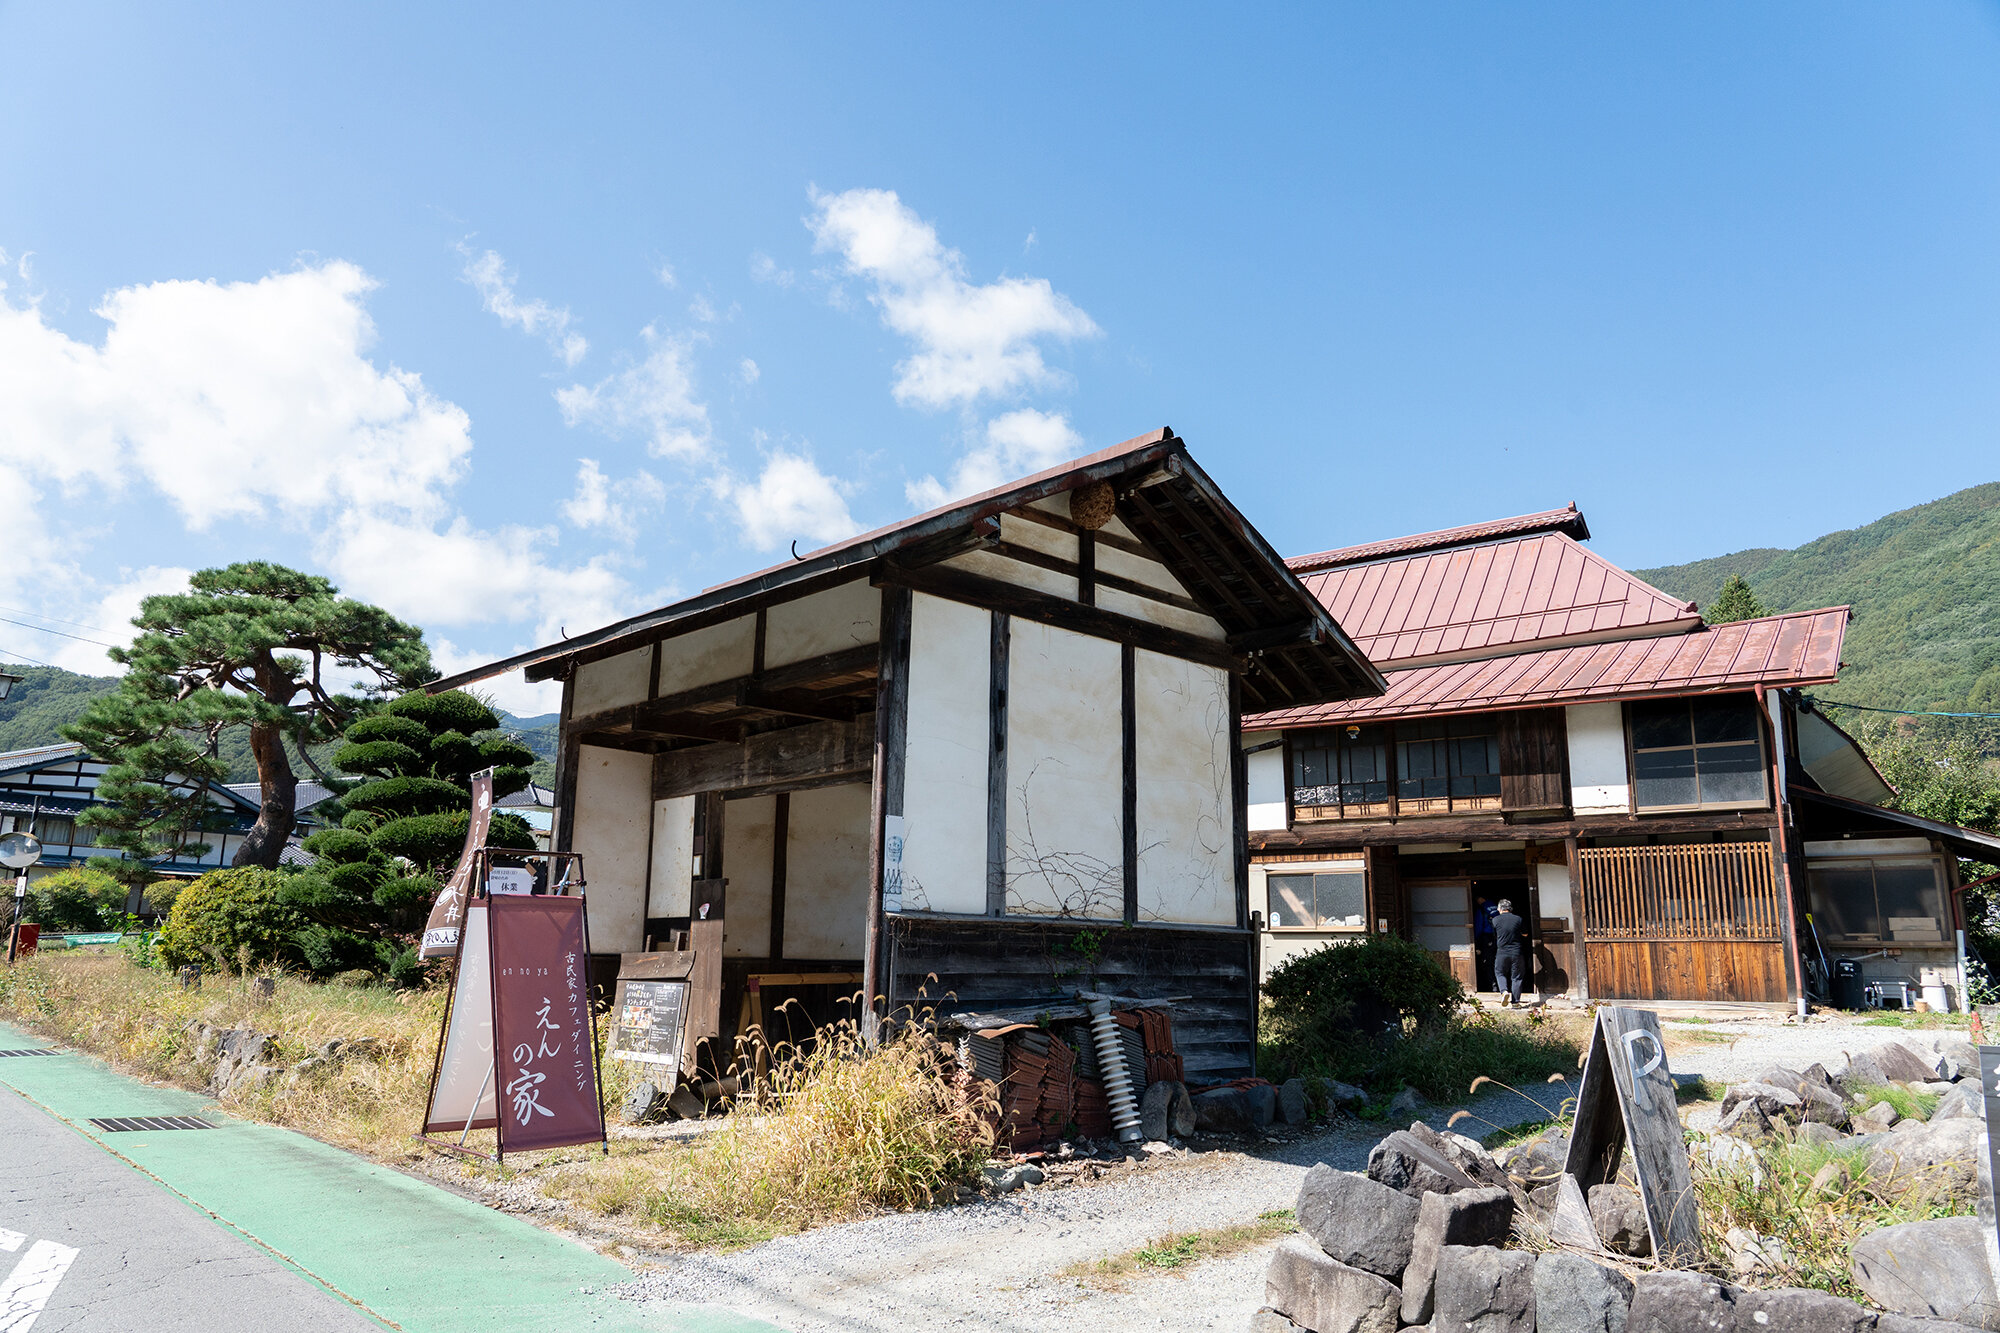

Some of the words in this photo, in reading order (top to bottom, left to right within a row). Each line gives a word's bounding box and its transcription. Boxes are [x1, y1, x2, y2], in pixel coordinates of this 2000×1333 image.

[501, 882, 518, 891] 休業
[502, 968, 513, 976] en
[520, 968, 531, 976] no
[537, 968, 548, 976] ya
[565, 952, 586, 1091] 古民家カフェダイニング
[1620, 1029, 1662, 1105] P
